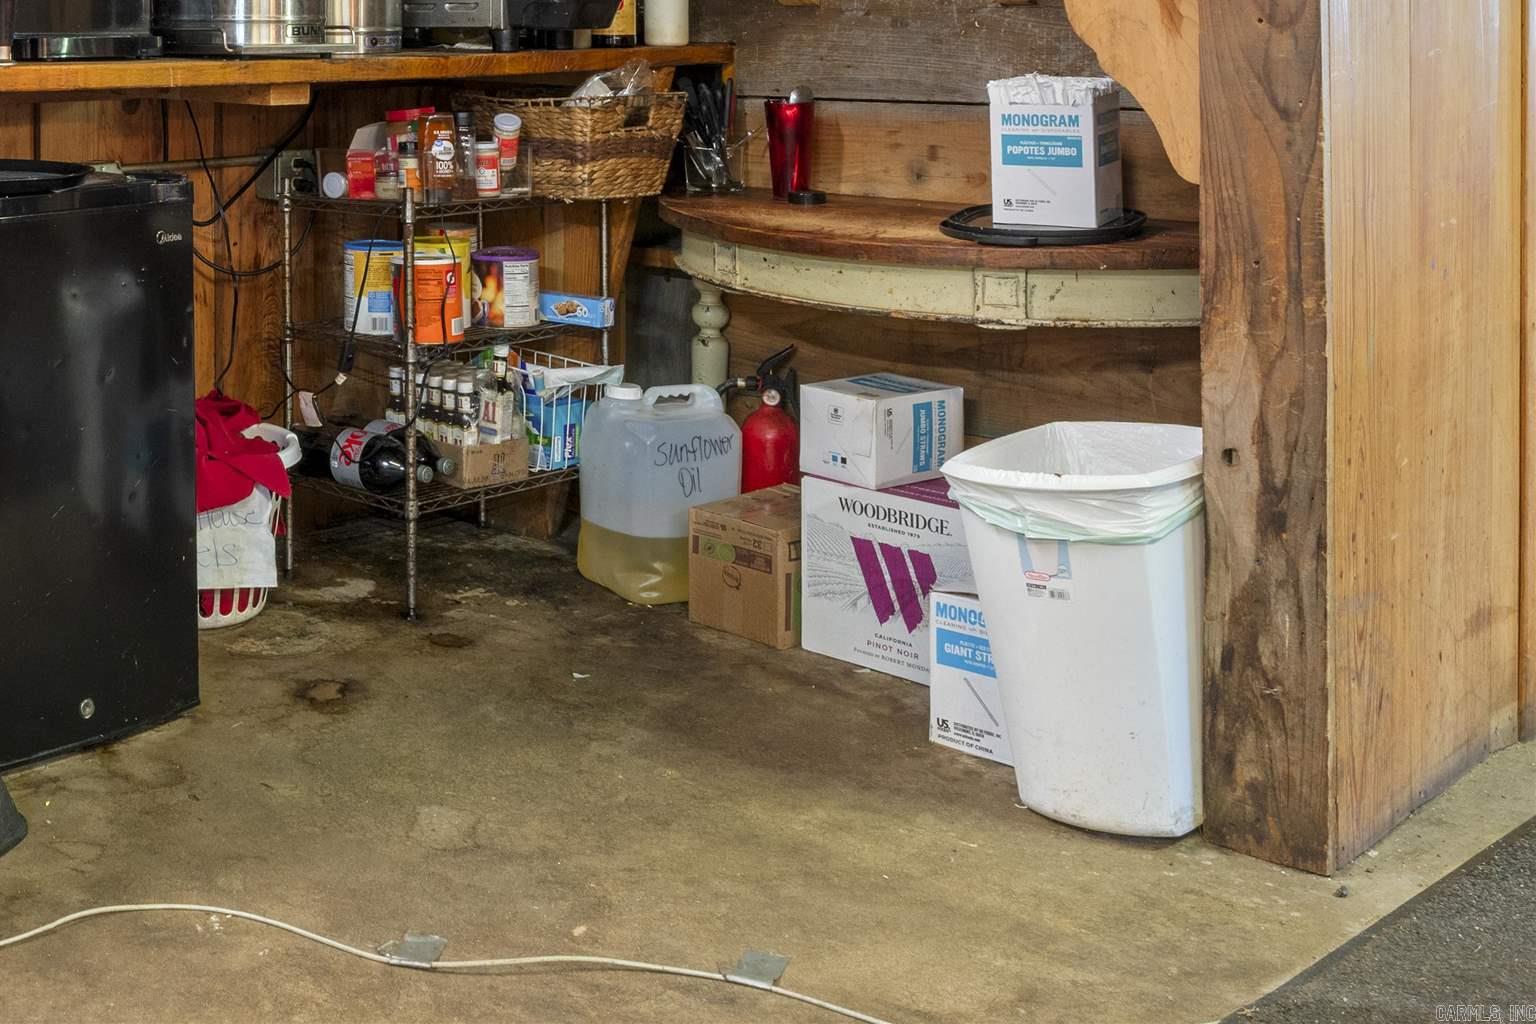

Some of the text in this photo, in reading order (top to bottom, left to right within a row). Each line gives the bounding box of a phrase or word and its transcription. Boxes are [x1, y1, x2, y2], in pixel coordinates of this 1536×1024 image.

[1001, 113, 1080, 128] MONOGRAM
[1007, 145, 1077, 157] POPOTES JUMBO
[435, 160, 454, 170] 100%
[654, 433, 734, 466] Sunflower
[678, 466, 702, 498] Oil
[874, 632, 913, 648] CALIFORNIA
[866, 639, 920, 660] PINOT NOIR
[944, 642, 974, 659] GIANT
[938, 733, 965, 746] PRODUCT
[975, 744, 994, 754] CHINA
